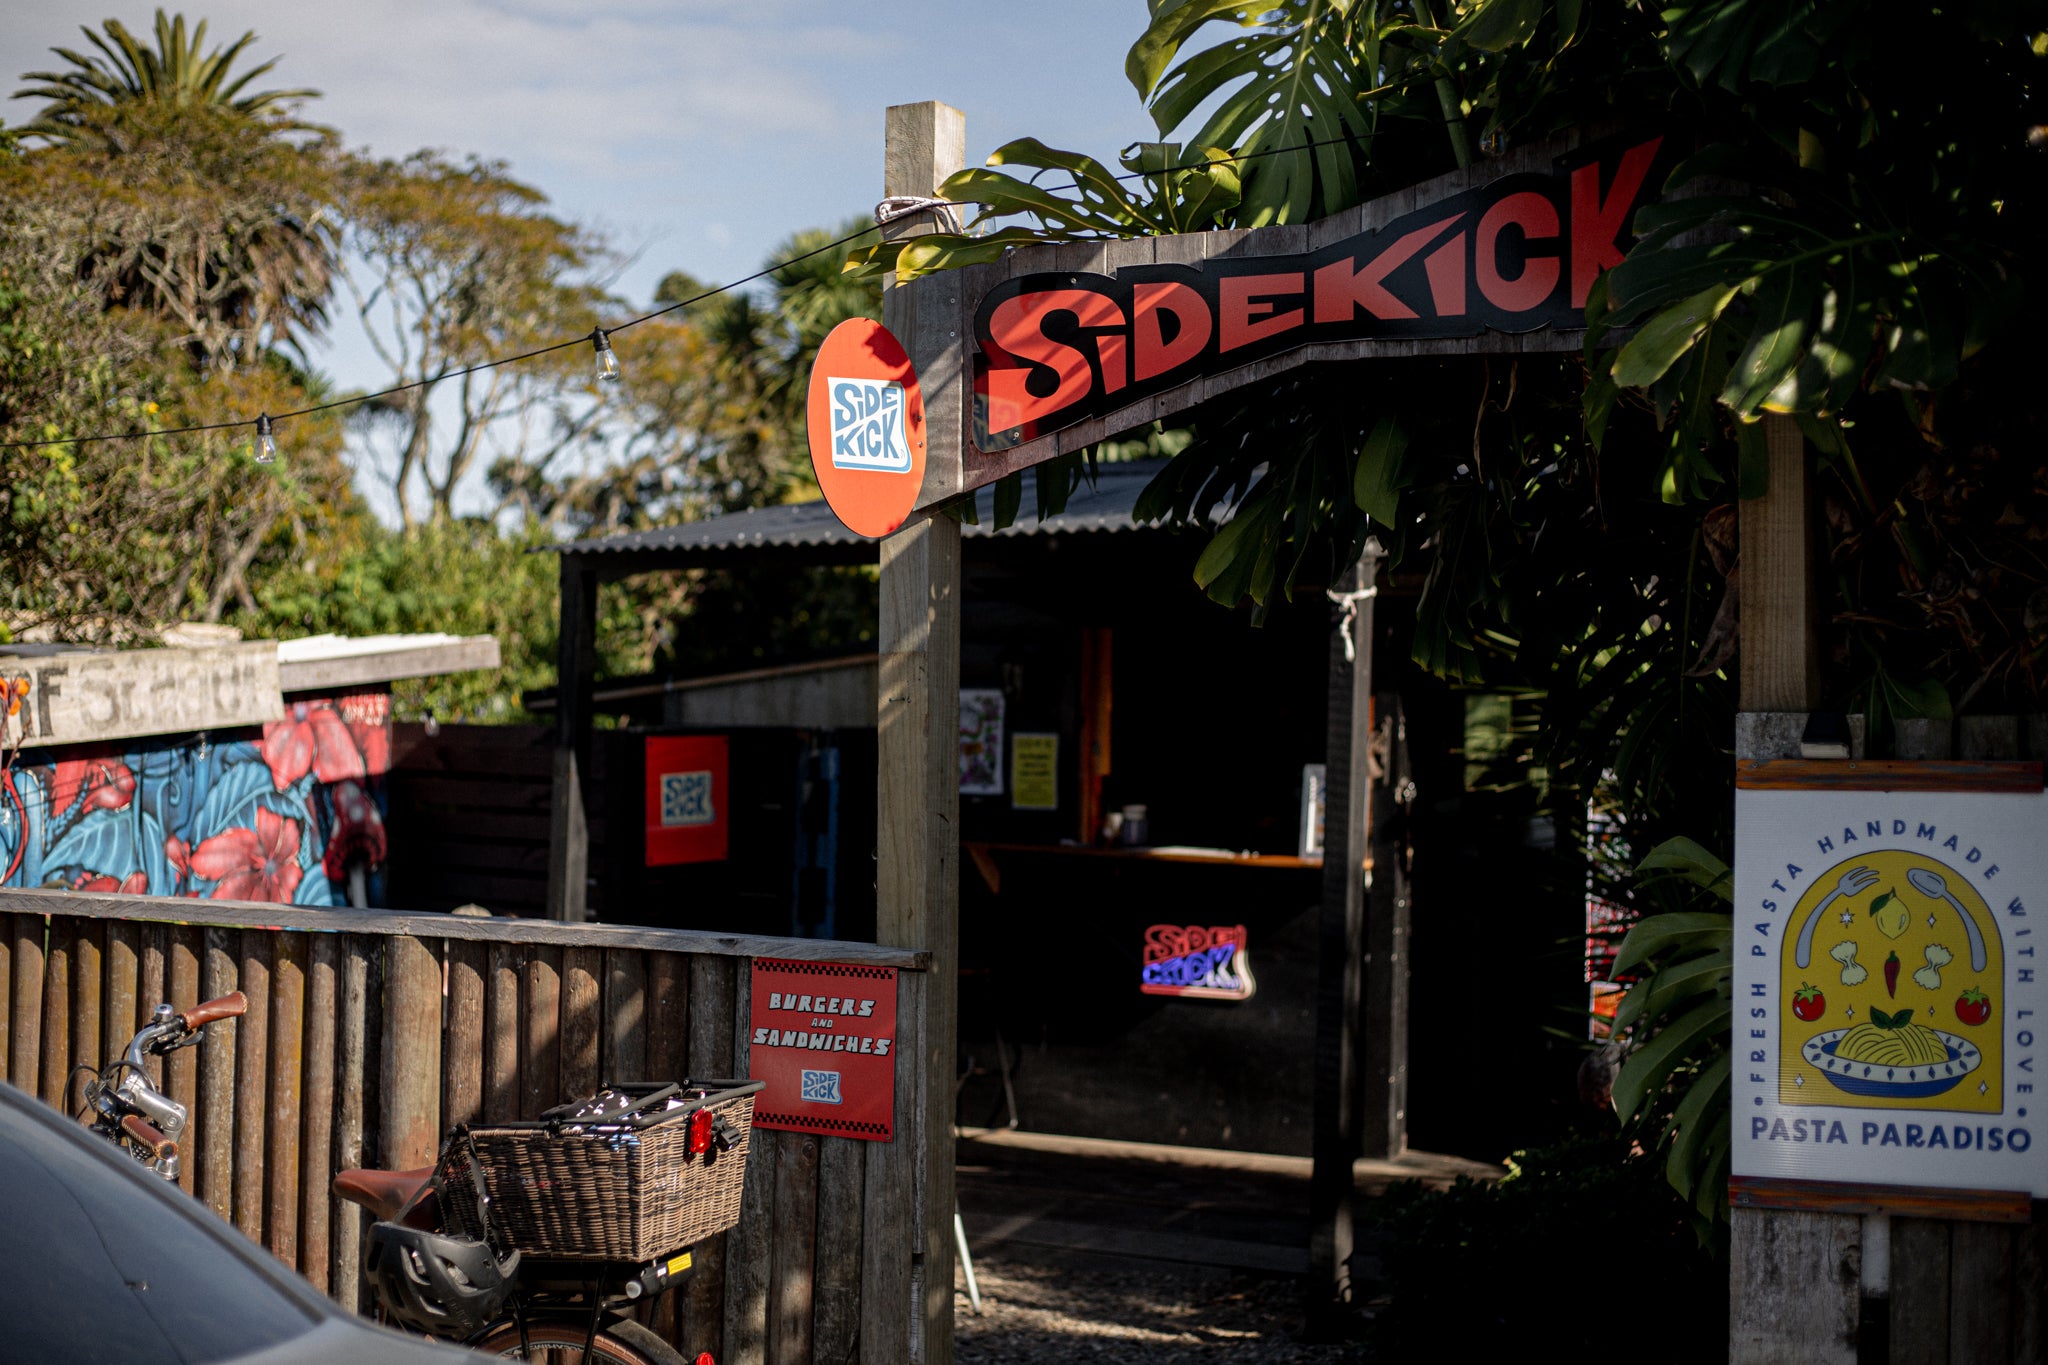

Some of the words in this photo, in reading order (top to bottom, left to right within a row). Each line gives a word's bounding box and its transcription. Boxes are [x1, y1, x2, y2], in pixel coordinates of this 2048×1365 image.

[987, 135, 1664, 435] SIDEKICK
[834, 382, 898, 432] SIDE
[836, 407, 899, 459] KICK
[1817, 819, 2000, 881] HANDMADE
[1751, 862, 1804, 957] PASTA
[2007, 896, 2035, 983] WITH
[769, 992, 876, 1017] BURGERS
[811, 1017, 834, 1029] AND
[752, 1028, 892, 1056] SANDWICHES
[1750, 983, 1767, 1083] FRESH
[2016, 1009, 2034, 1094] LOVE
[803, 1071, 837, 1088] SIDE
[803, 1082, 836, 1099] KICK
[1751, 1116, 1848, 1145] PASTA
[1862, 1121, 2032, 1153] PARADISO
